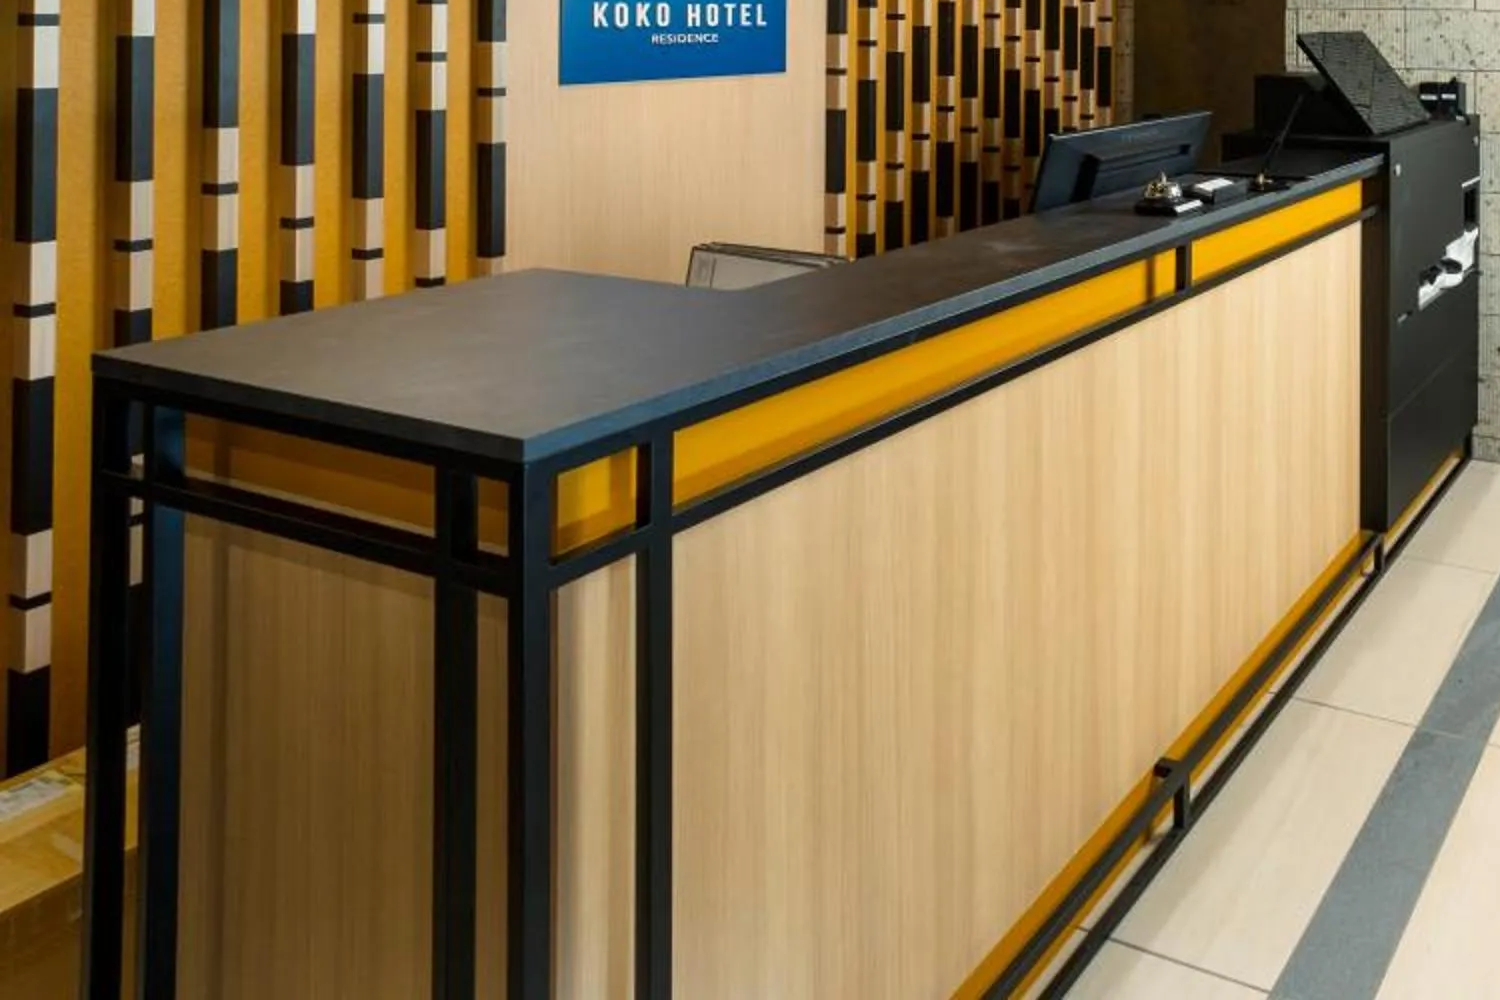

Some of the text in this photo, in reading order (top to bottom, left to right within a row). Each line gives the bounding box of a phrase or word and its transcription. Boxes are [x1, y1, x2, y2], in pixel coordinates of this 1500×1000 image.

[593, 1, 767, 28] KOKO HOTEL
[651, 33, 720, 44] RESIDENCE
